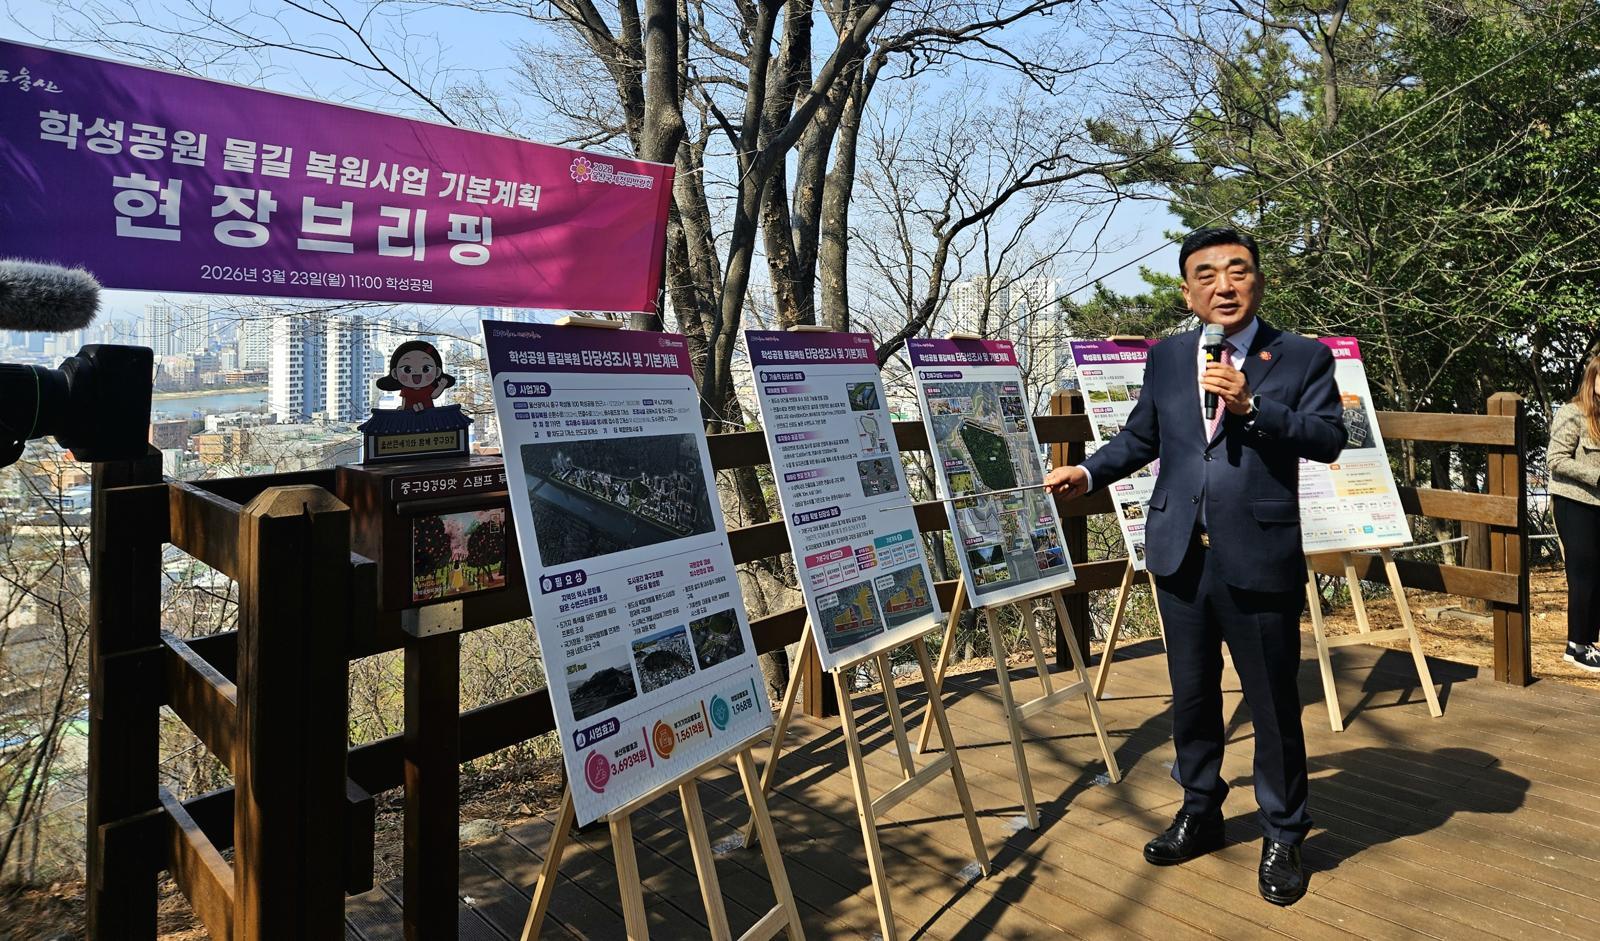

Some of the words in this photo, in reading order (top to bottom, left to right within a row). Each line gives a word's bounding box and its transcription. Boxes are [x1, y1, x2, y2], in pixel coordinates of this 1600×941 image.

[40, 109, 208, 167] 학성공원
[223, 137, 293, 179] 물길
[305, 150, 430, 197] 복원사업
[438, 171, 542, 212] 기본계획
[112, 172, 493, 266] 현장브리핑
[200, 264, 258, 283] 2026년
[261, 269, 286, 284] 3월
[290, 271, 346, 288] 23일(월)
[348, 273, 383, 290] 11:00
[385, 276, 433, 293] 학성공원
[508, 350, 546, 365] 학성공원
[547, 351, 581, 366] 물길복원
[581, 350, 631, 368] 타당성조사
[633, 352, 643, 367] 및
[644, 352, 679, 369] 기본계획
[520, 384, 547, 395] 사업개요
[400, 478, 458, 495] 중구9경9맛
[463, 475, 493, 488] 스탬프
[589, 720, 615, 742] 사업효과
[675, 721, 705, 744] 1,561억원
[610, 748, 648, 776] 3,693억원
